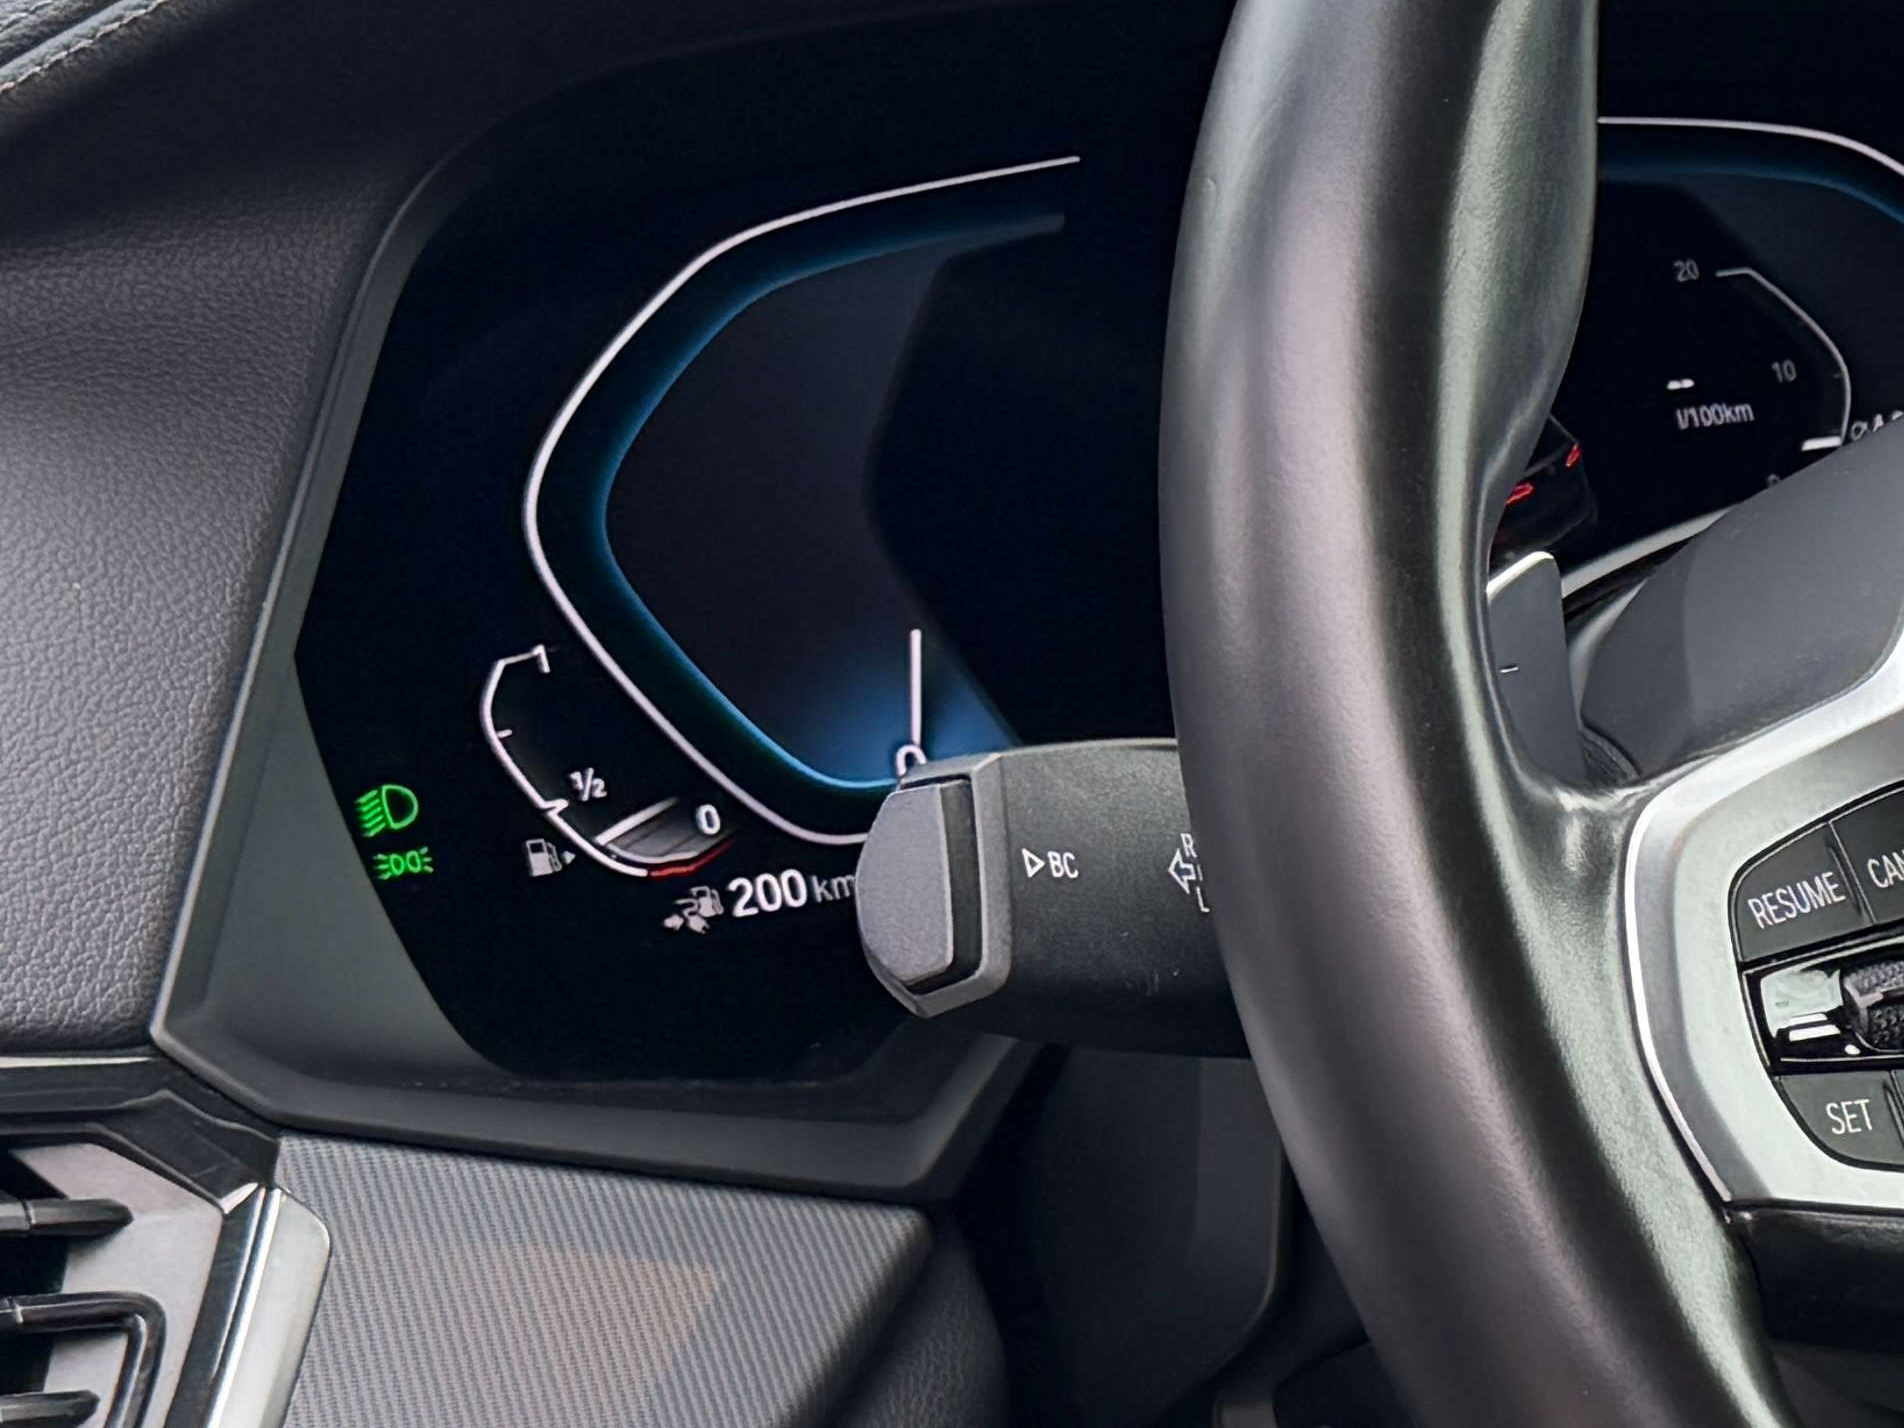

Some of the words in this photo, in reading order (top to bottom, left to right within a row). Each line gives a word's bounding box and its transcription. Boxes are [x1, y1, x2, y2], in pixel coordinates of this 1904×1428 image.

[1674, 259, 1700, 283] 20
[1771, 359, 1797, 384] 10
[695, 803, 721, 835] 0
[1047, 851, 1079, 879] BC
[727, 869, 808, 919] 200
[1747, 871, 1846, 930] RESUME
[1825, 1098, 1873, 1136] SET
